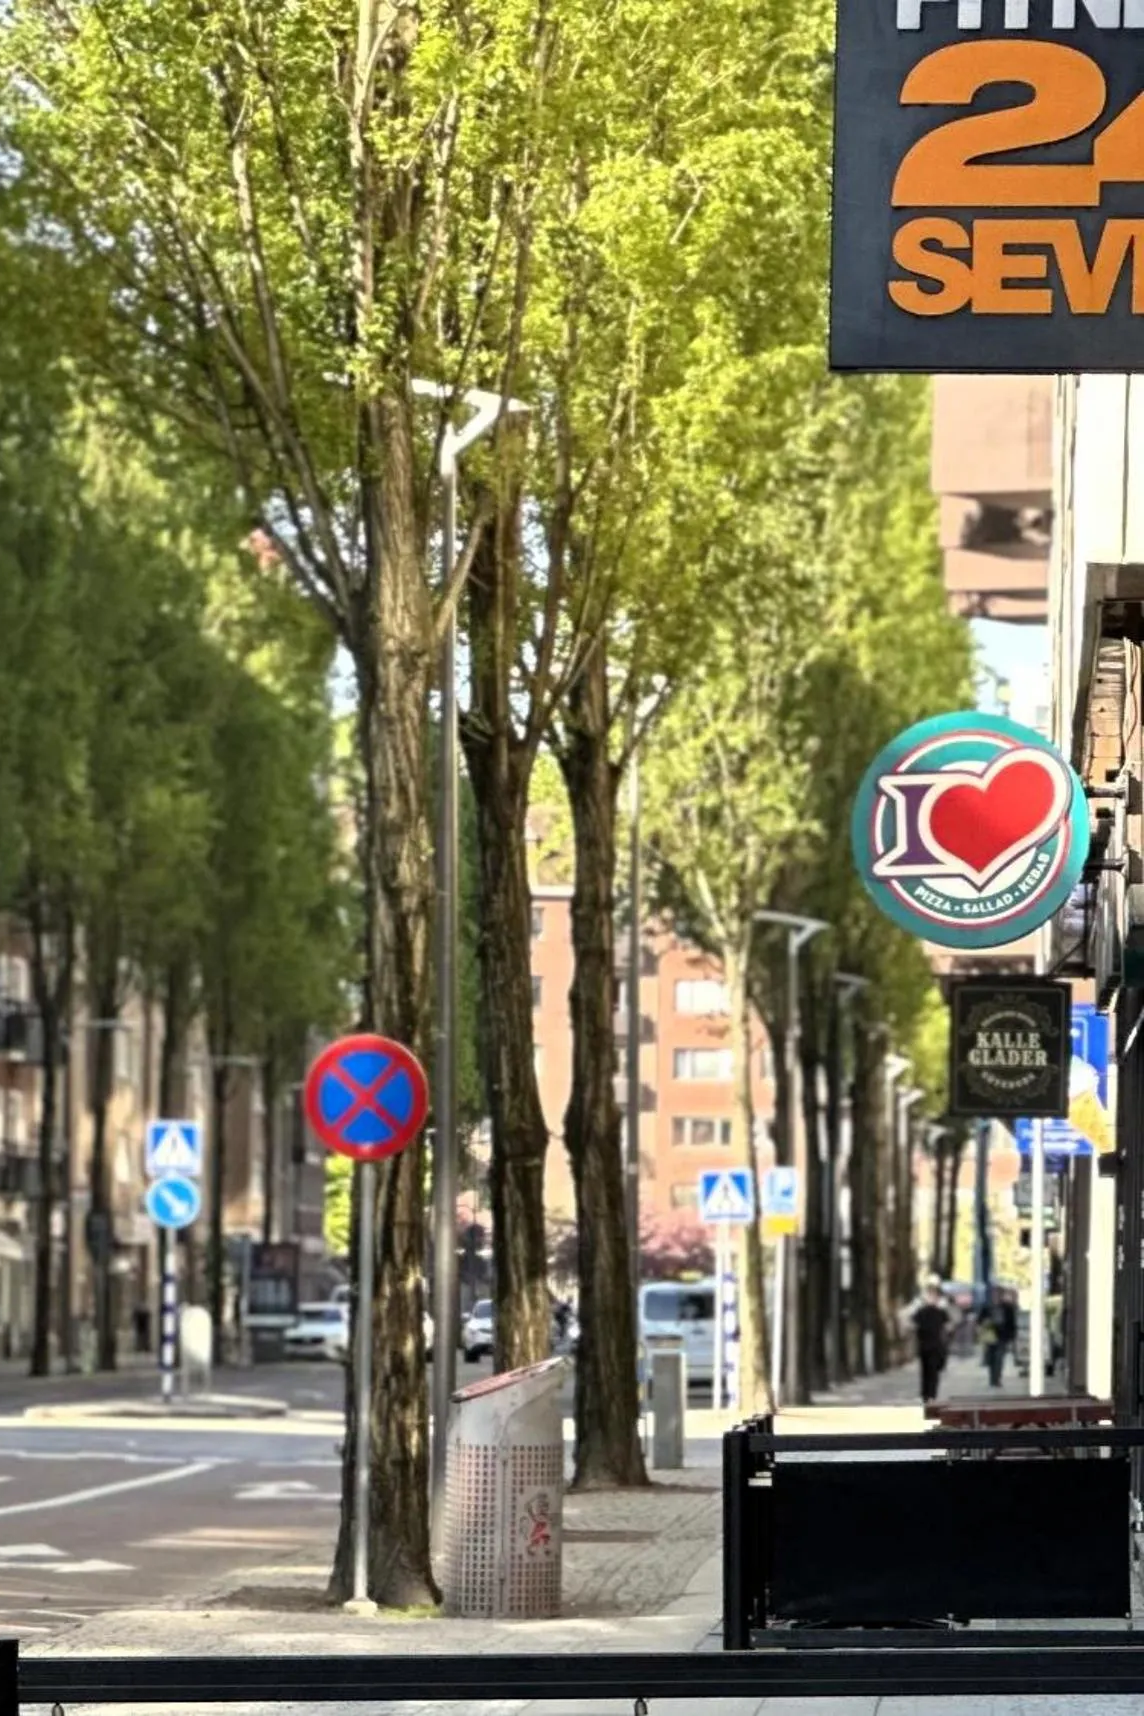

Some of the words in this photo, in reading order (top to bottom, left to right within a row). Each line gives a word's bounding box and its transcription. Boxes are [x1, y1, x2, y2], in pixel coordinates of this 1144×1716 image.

[891, 38, 1144, 207] 2
[888, 216, 1144, 316] SEV
[913, 886, 952, 912] PIZZA
[962, 893, 1014, 914] SALLAD
[1019, 852, 1051, 894] KEBAB
[976, 1031, 1041, 1049] KALLE
